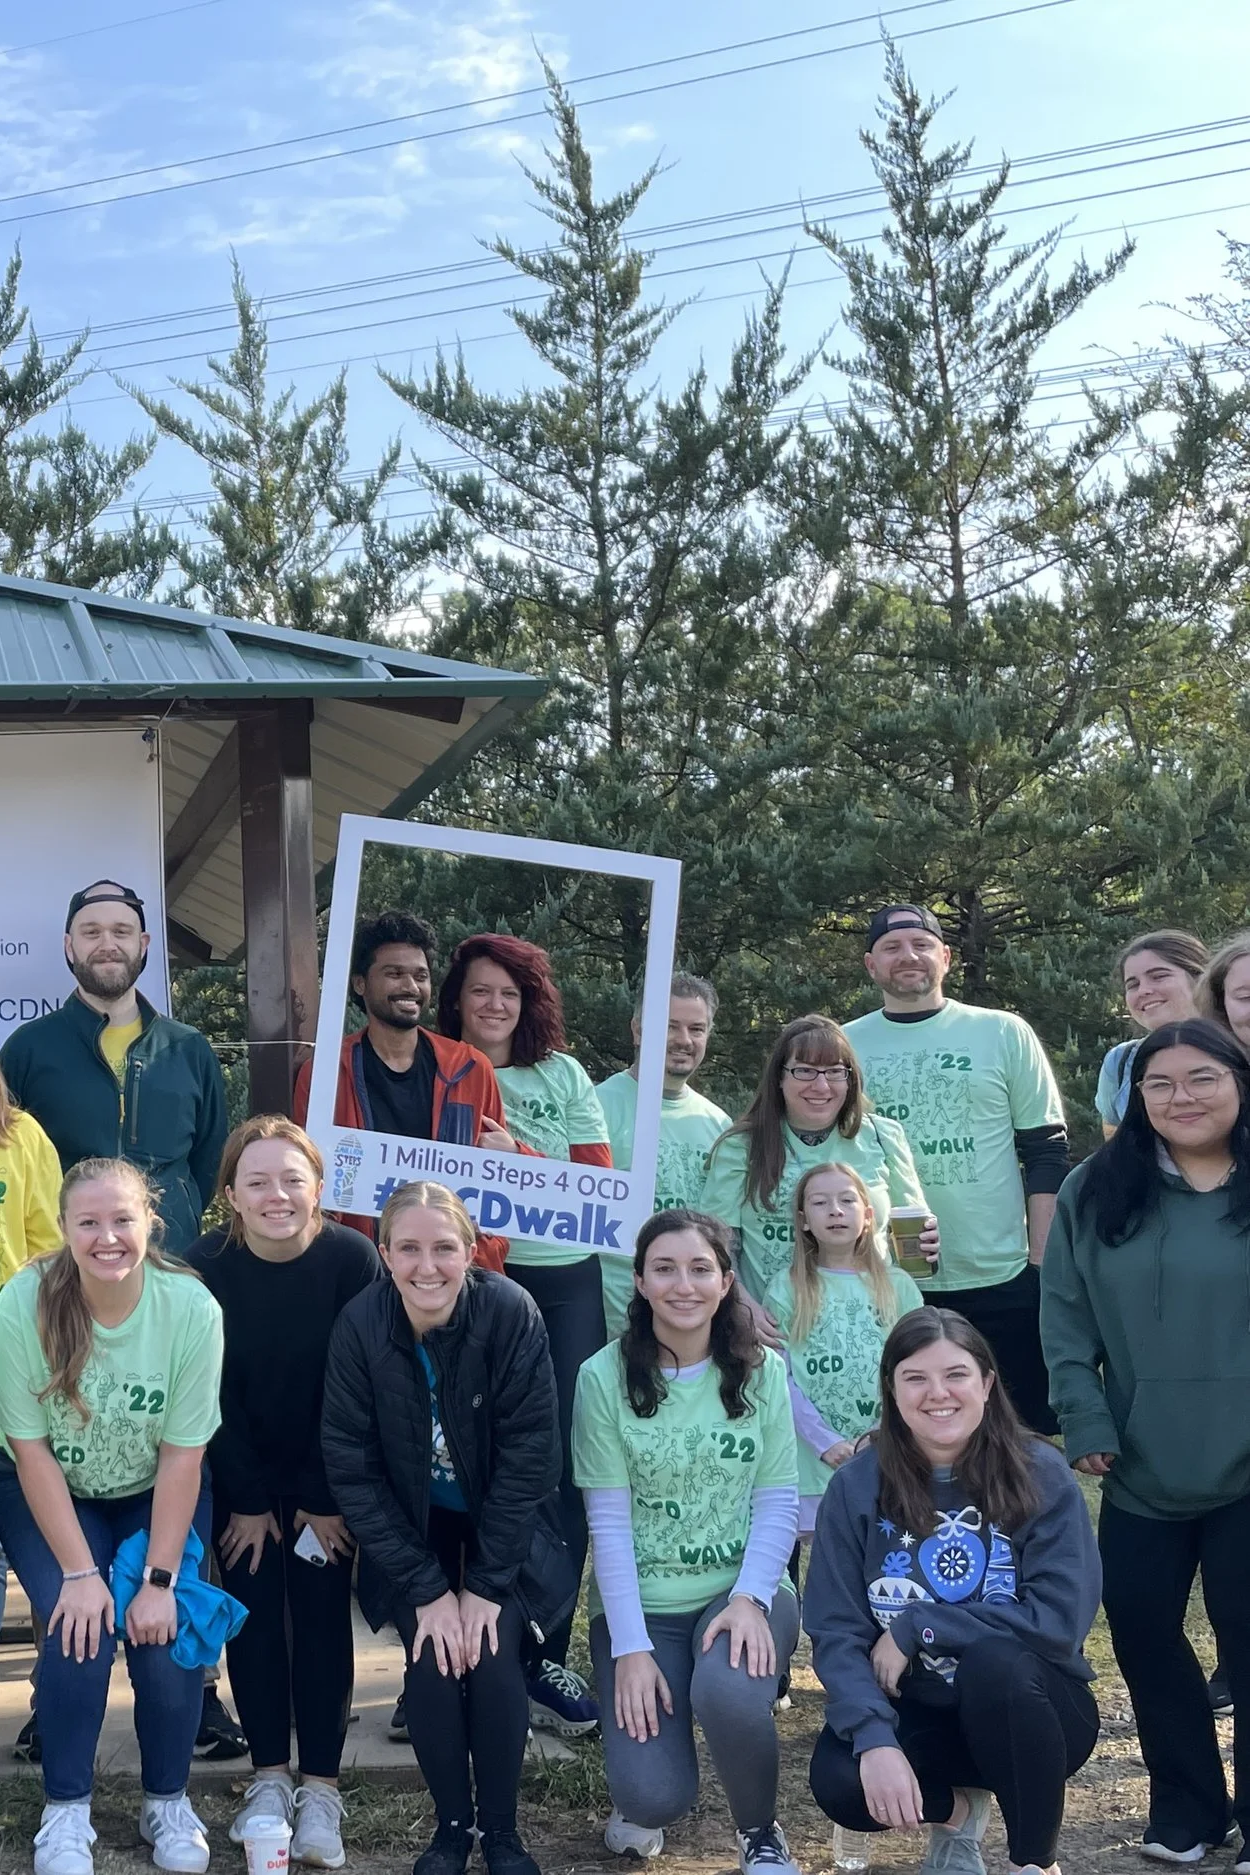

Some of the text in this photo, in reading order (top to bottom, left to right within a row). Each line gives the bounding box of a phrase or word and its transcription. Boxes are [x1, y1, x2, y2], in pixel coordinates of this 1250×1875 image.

[935, 1053, 972, 1071] '22
[522, 1100, 560, 1121] '22
[919, 1137, 975, 1156] WALK
[380, 1143, 630, 1201] 1 Million Steps 4 OCD
[806, 1355, 843, 1375] OCD
[123, 1383, 165, 1414] '22
[55, 1445, 86, 1464] CD
[711, 1432, 756, 1462] '22
